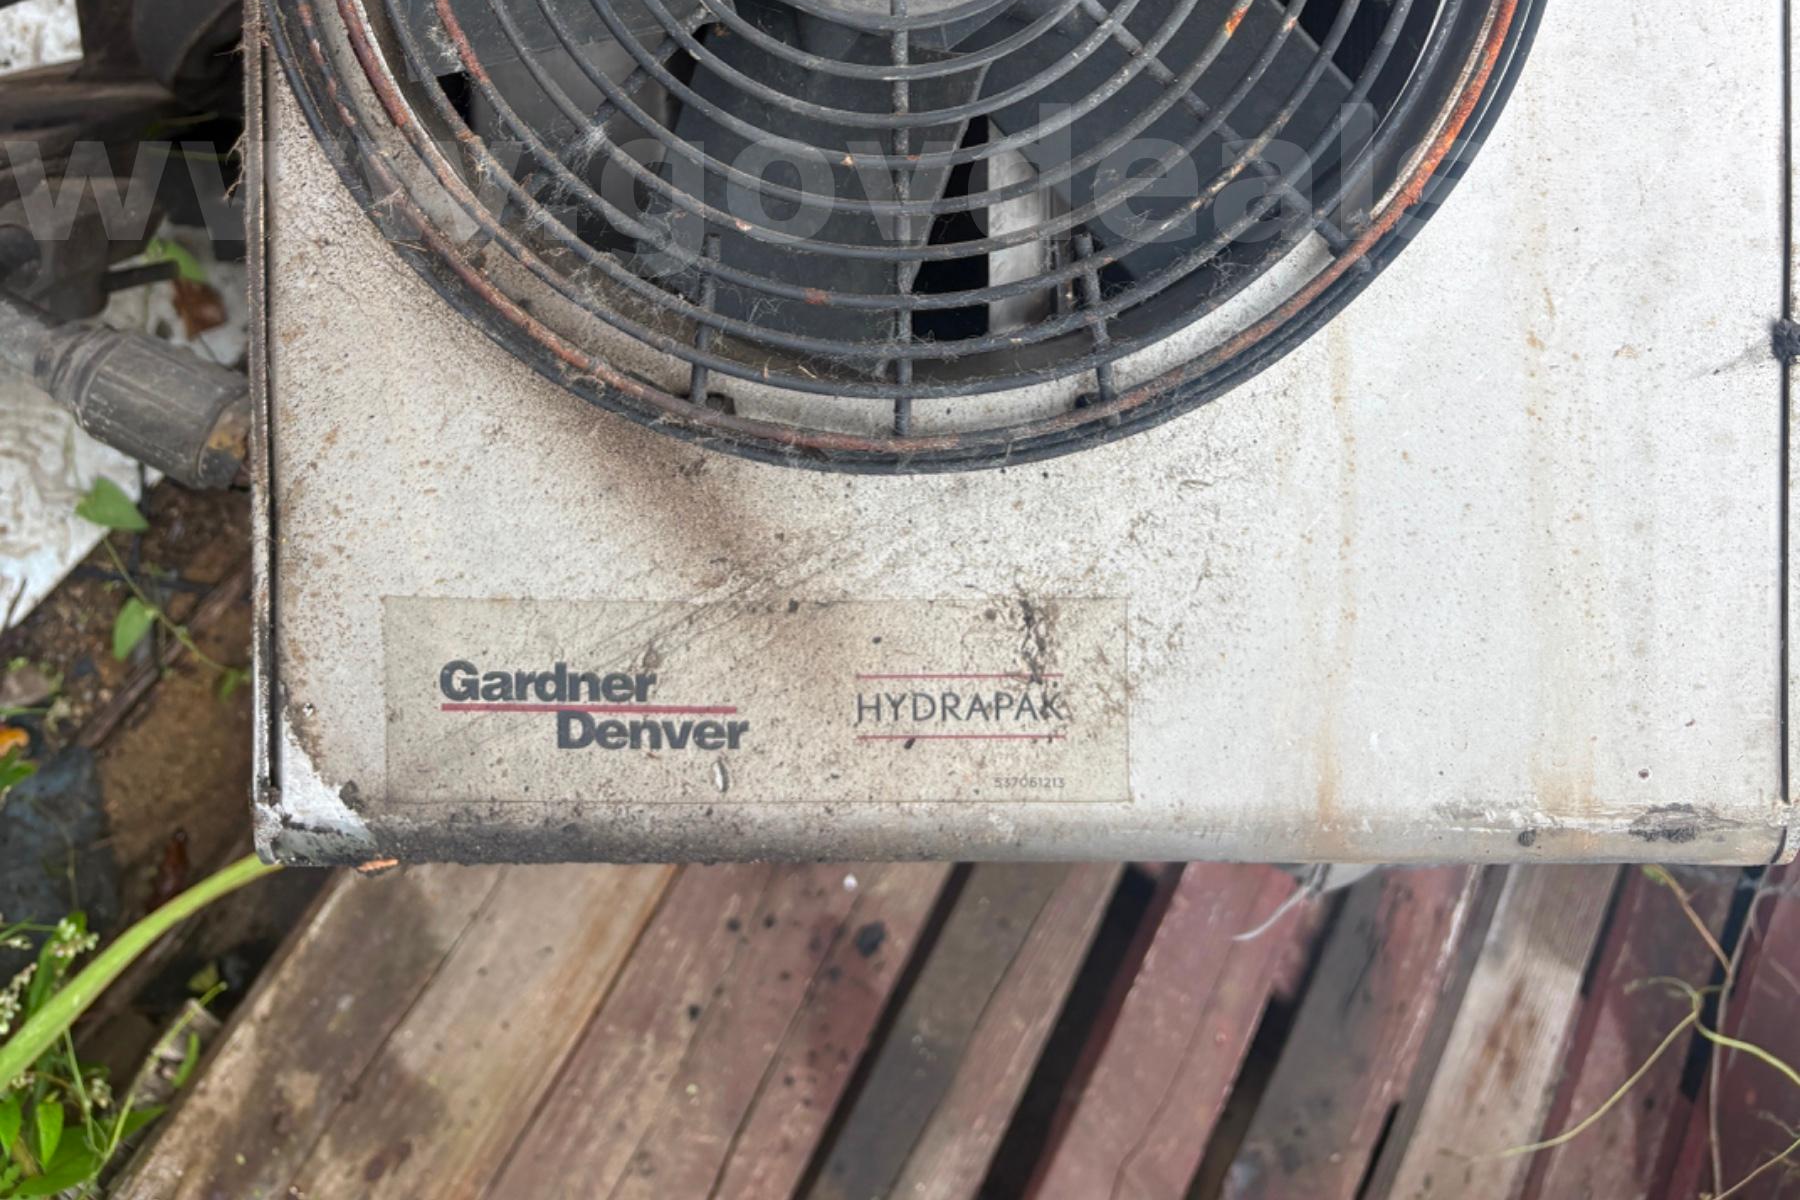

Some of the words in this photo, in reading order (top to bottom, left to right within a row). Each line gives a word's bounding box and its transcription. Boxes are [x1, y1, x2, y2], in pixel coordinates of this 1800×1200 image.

[439, 659, 657, 702] Gardner
[856, 692, 1065, 723] HYDRAPAK
[556, 709, 750, 750] Denver
